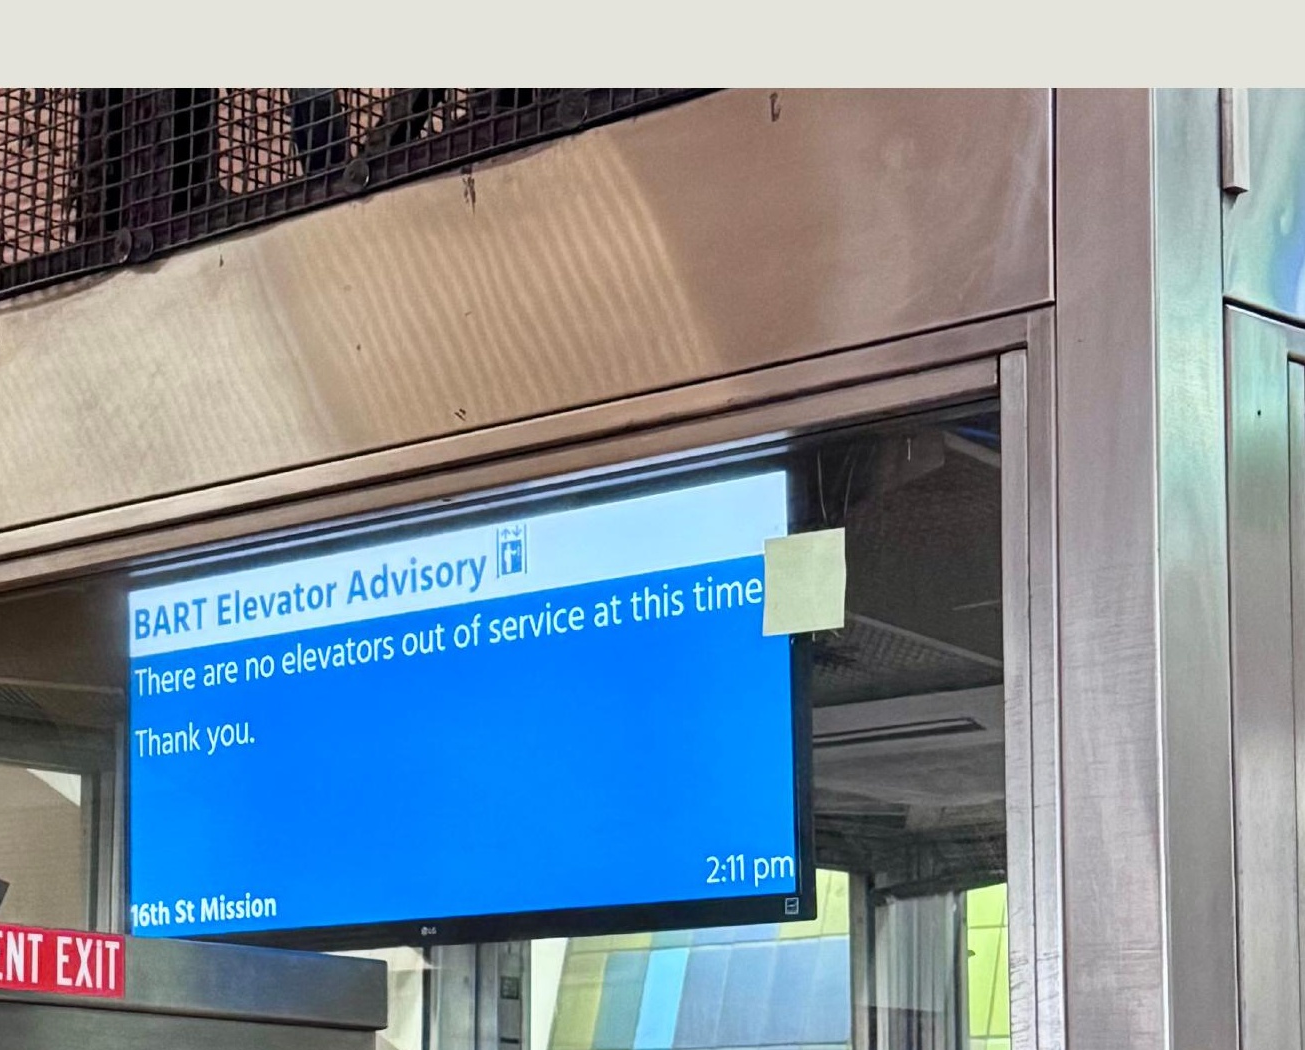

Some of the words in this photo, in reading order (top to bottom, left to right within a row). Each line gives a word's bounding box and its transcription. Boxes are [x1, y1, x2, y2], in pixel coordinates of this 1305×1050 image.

[134, 598, 207, 640] BART
[217, 581, 337, 626] Elevator
[347, 555, 487, 605] Advisory
[134, 666, 196, 697] There
[203, 661, 238, 687] are
[245, 655, 275, 681] no
[281, 635, 394, 676] elevators
[401, 623, 445, 657] out
[453, 613, 482, 649] of
[488, 602, 585, 644] service
[594, 598, 622, 628] at
[630, 583, 684, 622] this
[692, 575, 763, 613] time
[135, 722, 200, 758] Thank
[207, 721, 255, 755] you.
[706, 853, 745, 884] 2:11
[753, 855, 795, 888] pm
[130, 900, 170, 927] 16th
[175, 899, 195, 924] St
[201, 892, 277, 923] Mission
[56, 935, 121, 991] EXIT
